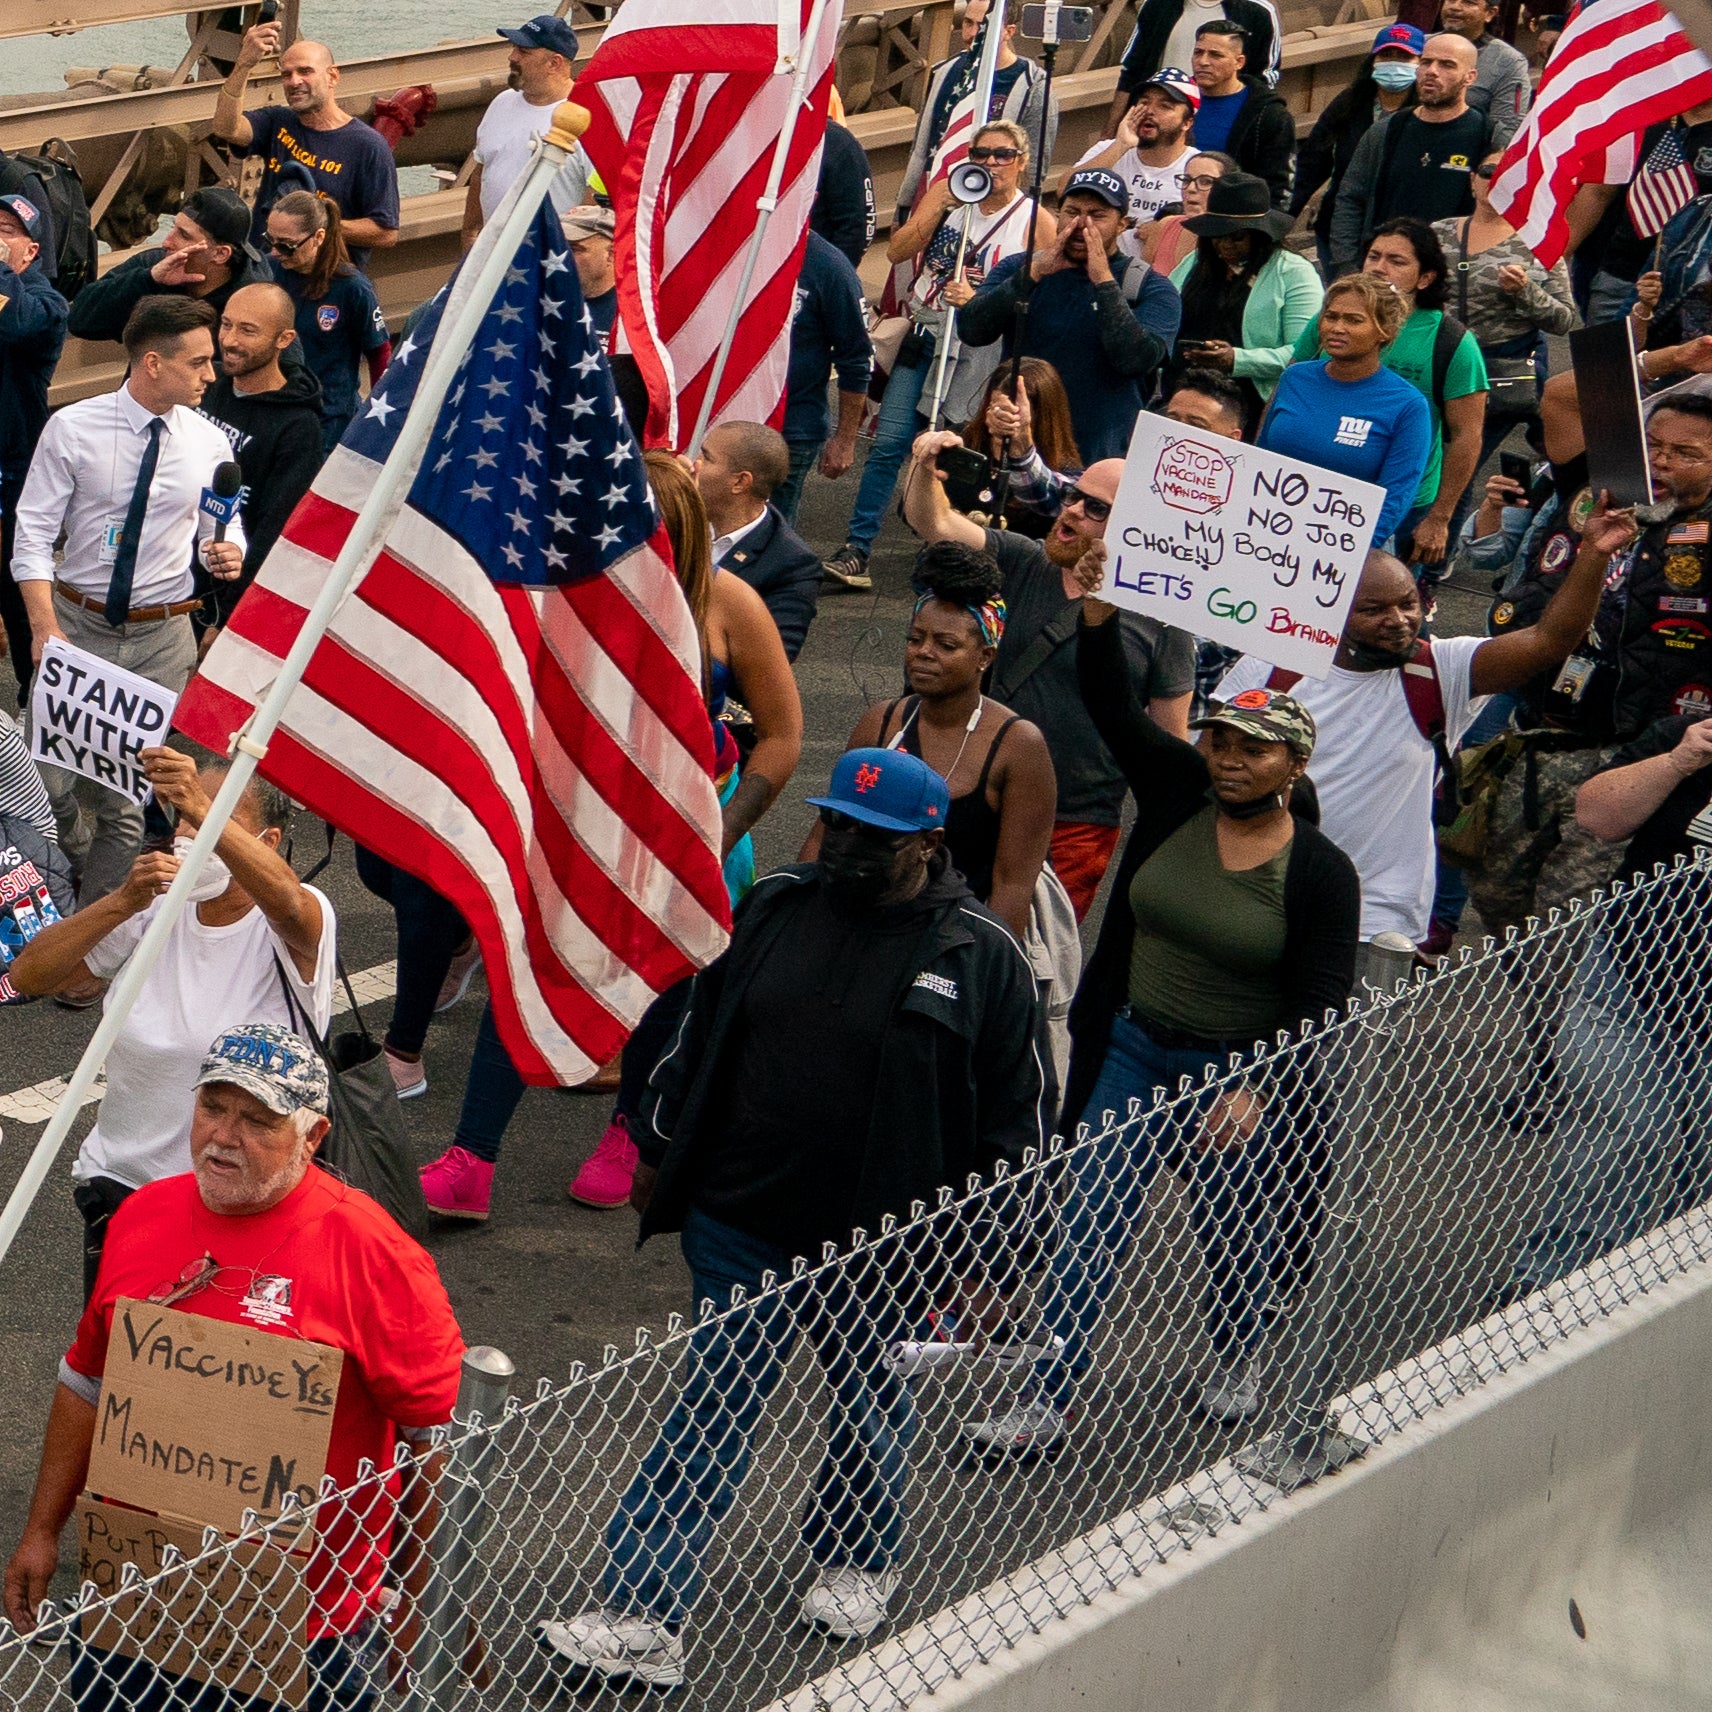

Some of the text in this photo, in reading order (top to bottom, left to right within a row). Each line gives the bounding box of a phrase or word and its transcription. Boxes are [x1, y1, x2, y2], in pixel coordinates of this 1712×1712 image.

[320, 159, 343, 175] 101
[1073, 172, 1121, 192] NYPD
[1162, 464, 1216, 489] VACCINE
[1171, 445, 1224, 475] STOP
[204, 496, 226, 516] NTD
[1163, 482, 1222, 505] MANDATES
[1313, 488, 1366, 528] JAB
[1207, 587, 1257, 624] GO
[42, 656, 165, 732] STAND
[45, 693, 145, 766] WITH
[40, 726, 149, 803] KYRIE
[215, 1035, 299, 1080] FDNY
[123, 1310, 287, 1397] VACCINE
[99, 1392, 259, 1494] MANDATE
[84, 1511, 140, 1556] PUT
